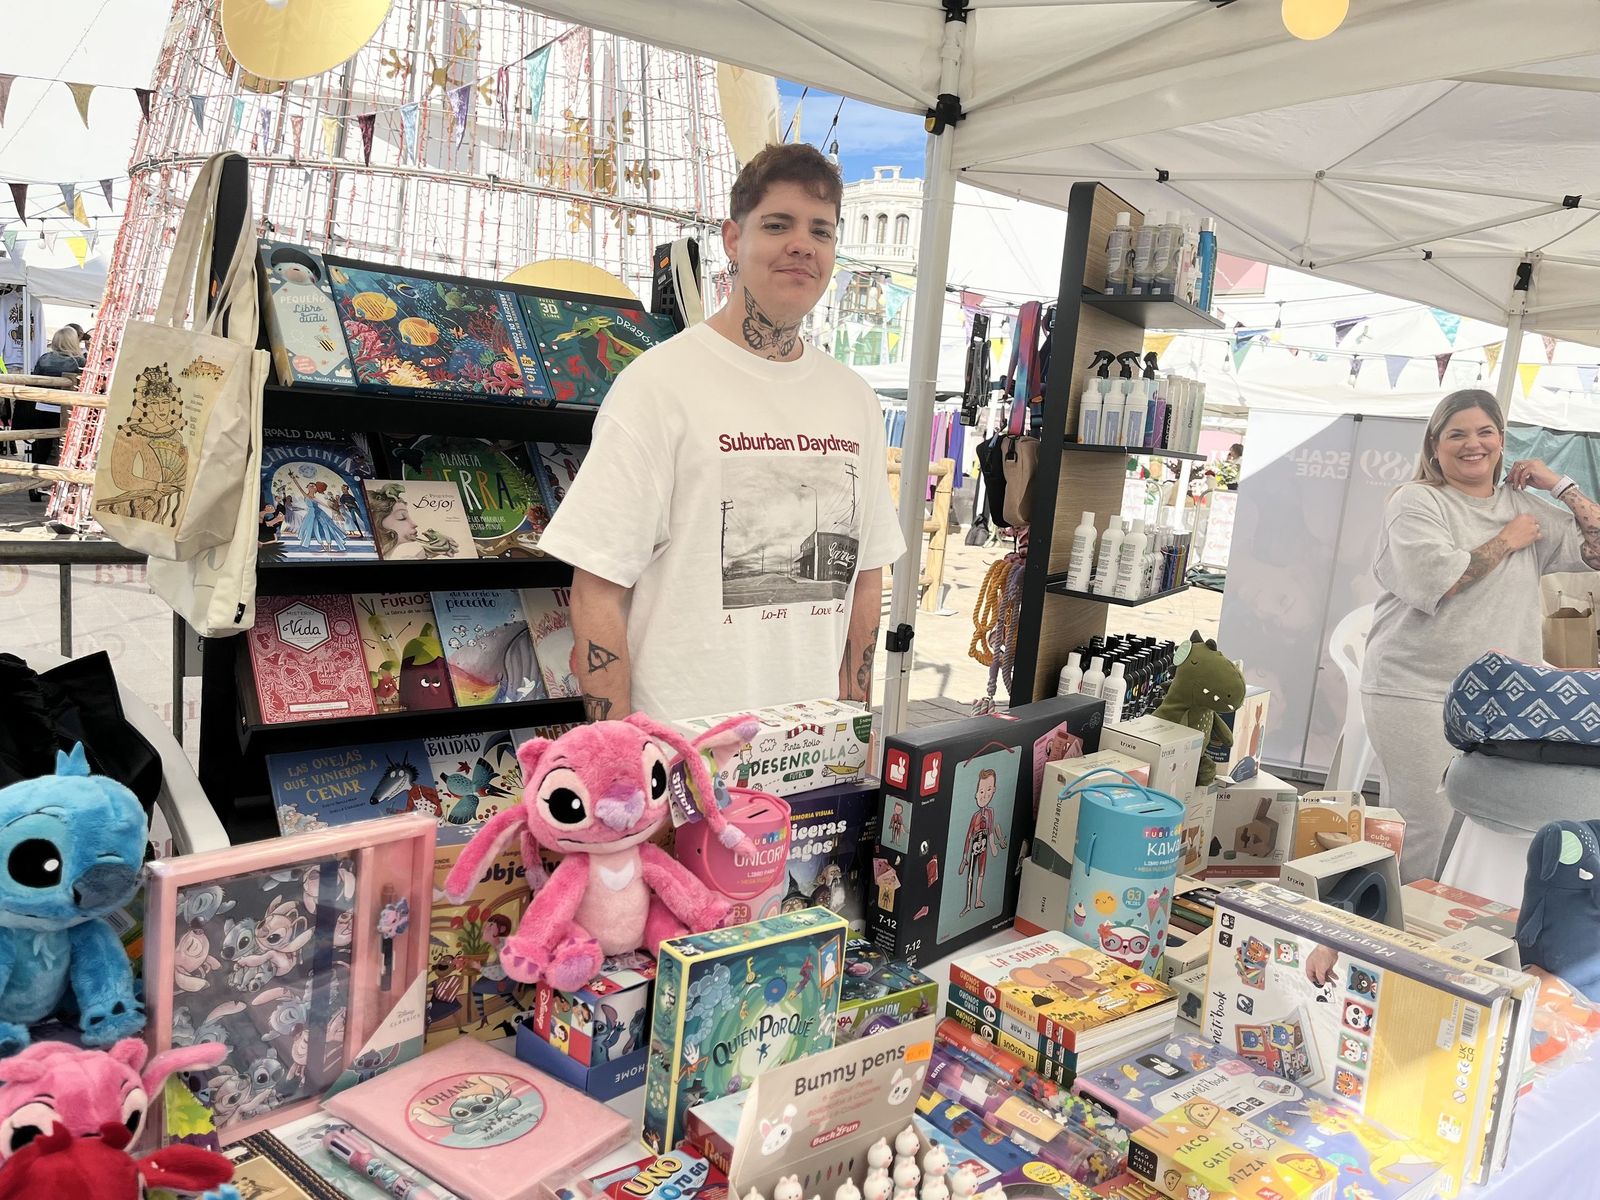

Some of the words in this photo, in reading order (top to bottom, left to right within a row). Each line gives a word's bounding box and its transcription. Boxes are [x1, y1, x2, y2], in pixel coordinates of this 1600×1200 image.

[280, 293, 326, 304] PEQUEÑO
[293, 304, 323, 313] Libro
[540, 303, 559, 314] 3D
[264, 427, 301, 438] ROALD
[305, 430, 336, 441] DAHL
[718, 432, 795, 453] Suburban
[796, 434, 860, 456] Daydream
[440, 453, 482, 467] PLANETA
[723, 614, 733, 624] A
[761, 608, 788, 620] Lo-Fi
[282, 619, 321, 636] Vida
[1120, 740, 1137, 750] trixie
[287, 763, 309, 778] LAS
[312, 749, 364, 768] OVEJAS
[750, 744, 847, 777] DESENROLLA
[283, 778, 309, 792] QUE
[305, 778, 366, 804] CENAR
[815, 809, 834, 818] VISUAL
[1051, 820, 1062, 844] PUZZLE
[1370, 833, 1390, 841] cube
[1287, 876, 1305, 887] trixie
[1127, 889, 1141, 900] 63
[878, 914, 897, 929] 7-12
[905, 939, 921, 954] 7-12
[990, 957, 1007, 969] LA
[1015, 942, 1060, 965] SABANA
[1009, 1022, 1023, 1036] MAR
[1024, 1031, 1032, 1040] EL
[1002, 1039, 1026, 1057] BOSQUE
[1028, 1053, 1035, 1063] EL
[794, 1060, 857, 1097] Bunny
[862, 1044, 906, 1077] pens
[930, 1062, 947, 1079] GLITTER
[1018, 1109, 1041, 1124] BIG
[1176, 1134, 1211, 1156] TACO
[1132, 1153, 1154, 1170] GATITO
[1134, 1147, 1150, 1161] TACO
[1202, 1141, 1245, 1170] GATITO
[673, 1174, 693, 1189] TO
[689, 1162, 708, 1177] GO
[1132, 1160, 1153, 1176] PIZZA
[1227, 1159, 1268, 1185] PIZZA
[623, 1156, 683, 1196] UNO
